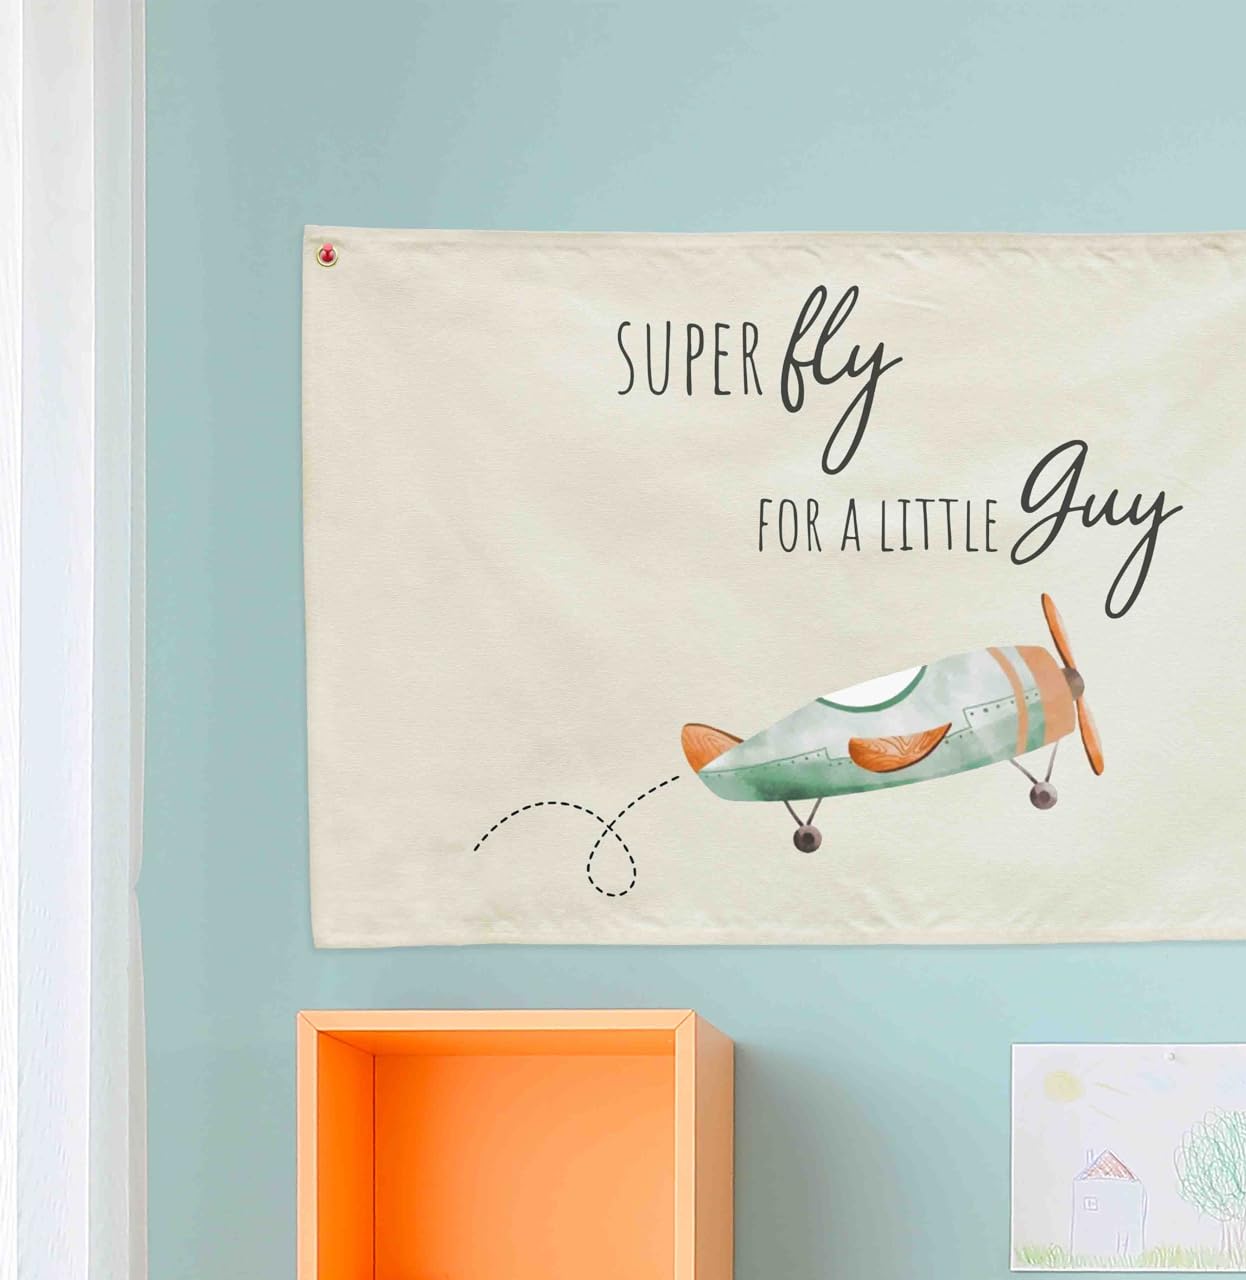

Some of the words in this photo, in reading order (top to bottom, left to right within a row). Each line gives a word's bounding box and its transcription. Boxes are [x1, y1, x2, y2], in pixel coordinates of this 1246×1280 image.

[616, 320, 764, 397] SUPER
[780, 284, 904, 476] fly
[758, 498, 823, 553] FOR
[840, 498, 861, 553] A
[881, 498, 999, 553] LITTLE
